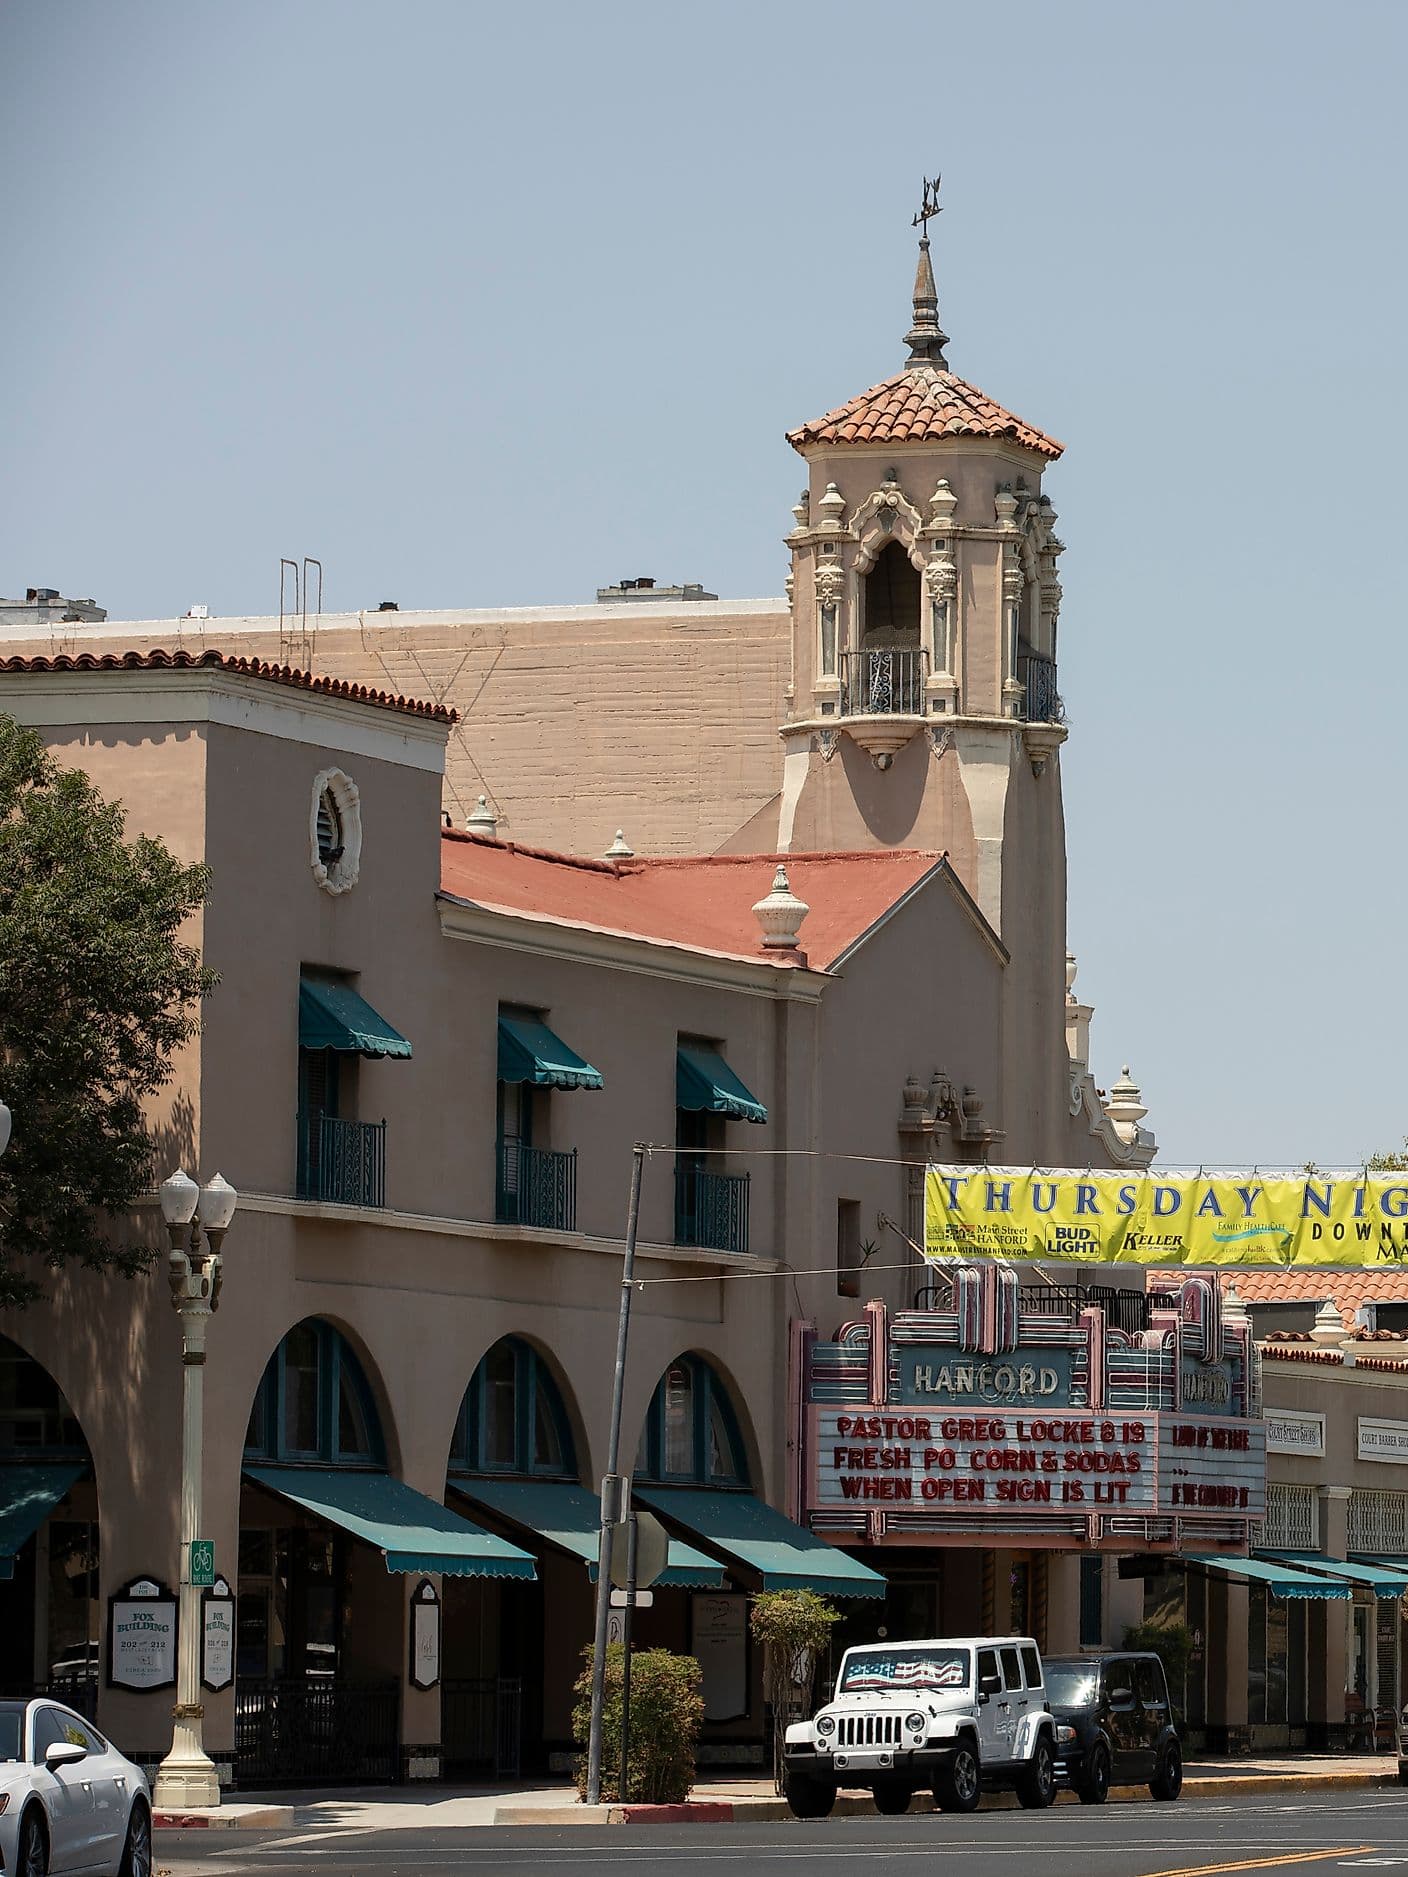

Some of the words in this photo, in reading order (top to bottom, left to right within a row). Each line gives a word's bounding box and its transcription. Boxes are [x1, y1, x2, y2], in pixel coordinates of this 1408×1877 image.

[941, 1177, 1264, 1218] THURSDAY
[976, 1225, 1000, 1235] Main
[1001, 1226, 1028, 1236] Street
[1055, 1227, 1091, 1240] BUD
[976, 1234, 1028, 1245] HANFORD
[1047, 1240, 1097, 1253] LIGHT
[1122, 1231, 1183, 1250] KELLER
[914, 1363, 1059, 1395] HANFORD
[837, 1416, 931, 1440] PASTOR
[941, 1418, 1006, 1441] GREG
[1016, 1420, 1095, 1442] LOCKE
[1100, 1421, 1115, 1442] 8
[1122, 1421, 1146, 1444] 19
[833, 1447, 911, 1470] FRESH
[924, 1448, 956, 1469] PO
[970, 1449, 1037, 1471] CORN
[1062, 1450, 1141, 1473] SODAS
[839, 1476, 912, 1500] WHEN
[920, 1477, 985, 1501] OPEN
[994, 1478, 1051, 1502] SIGN
[1061, 1479, 1085, 1502] IS
[1093, 1480, 1131, 1503] LIT
[132, 1613, 155, 1621] FOX
[117, 1622, 170, 1633] BUILDING
